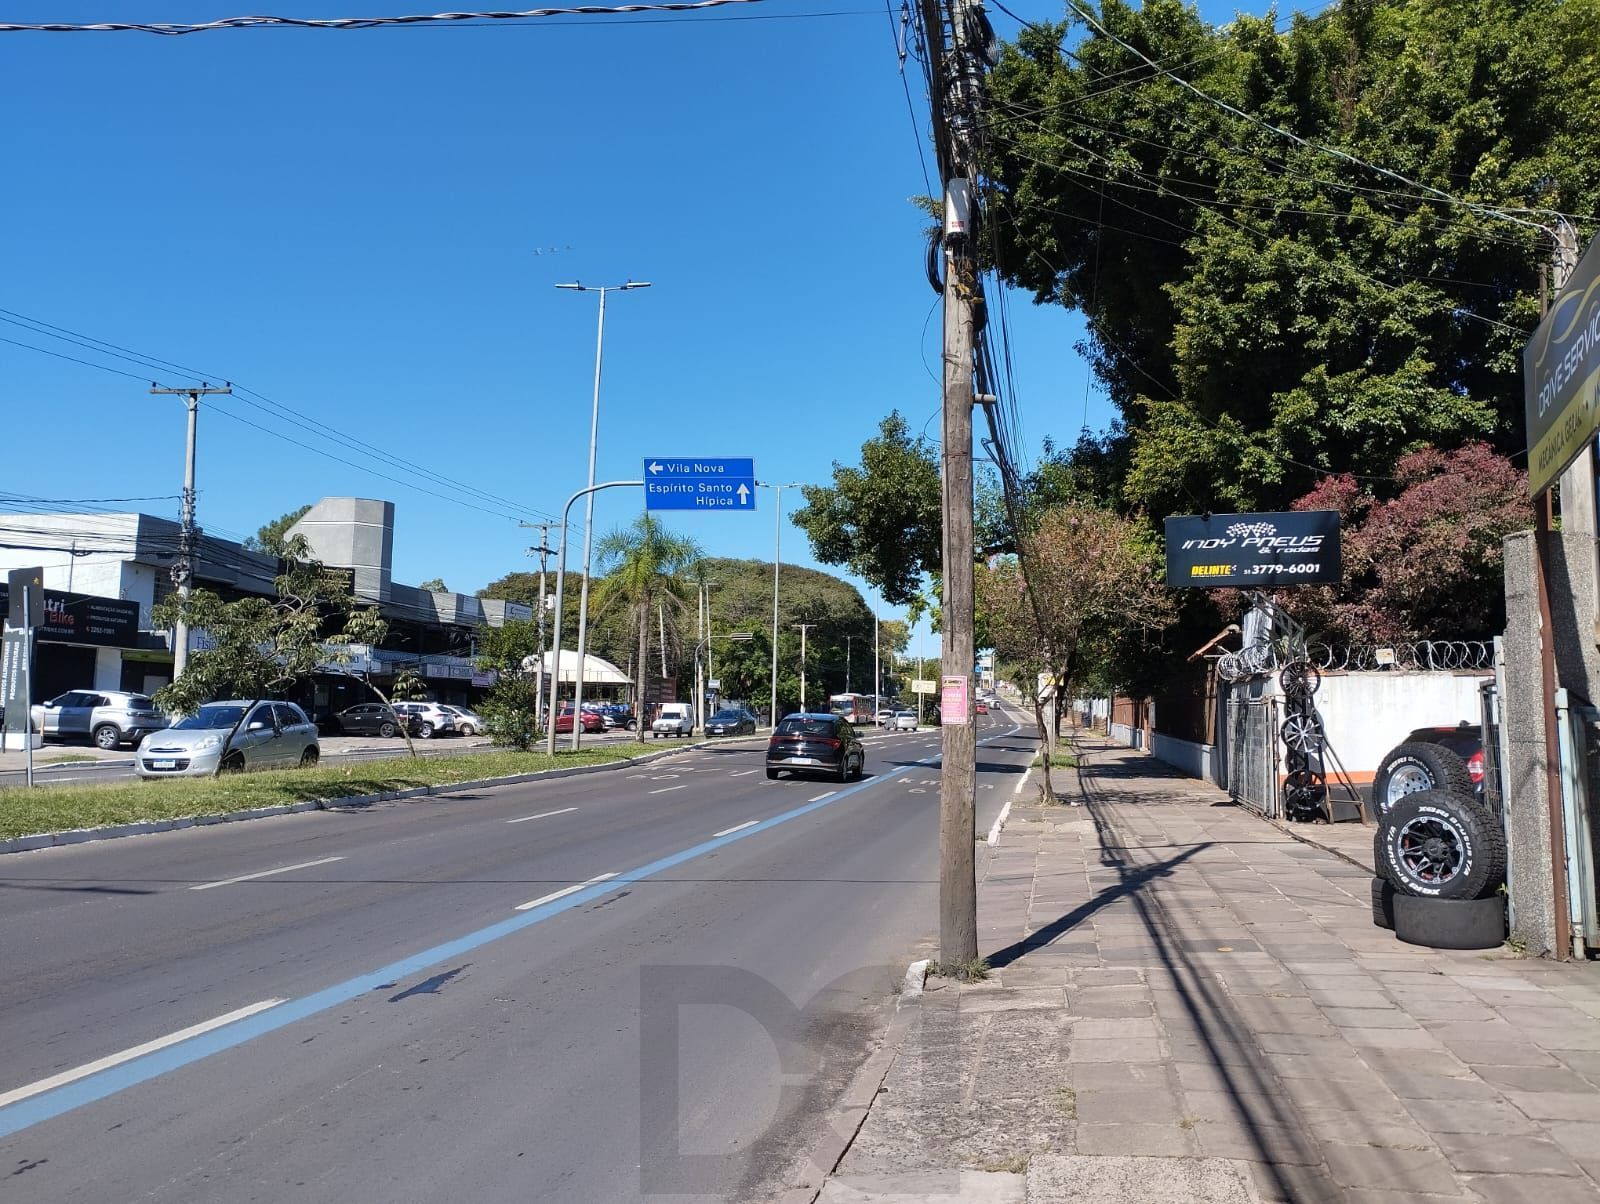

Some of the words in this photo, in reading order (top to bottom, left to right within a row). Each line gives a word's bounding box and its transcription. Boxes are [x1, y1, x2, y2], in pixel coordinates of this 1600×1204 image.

[1538, 362, 1563, 418] DRIVE
[667, 463, 690, 473] Vila
[694, 463, 725, 473] Nova
[649, 483, 694, 494] Espírito
[698, 483, 733, 493] Santo
[696, 496, 733, 507] Hípica
[1191, 564, 1232, 575] DELINTE
[1251, 563, 1321, 575] 3779-6001
[11, 641, 20, 669] NATURAIS
[9, 669, 17, 700] PRODUTOS
